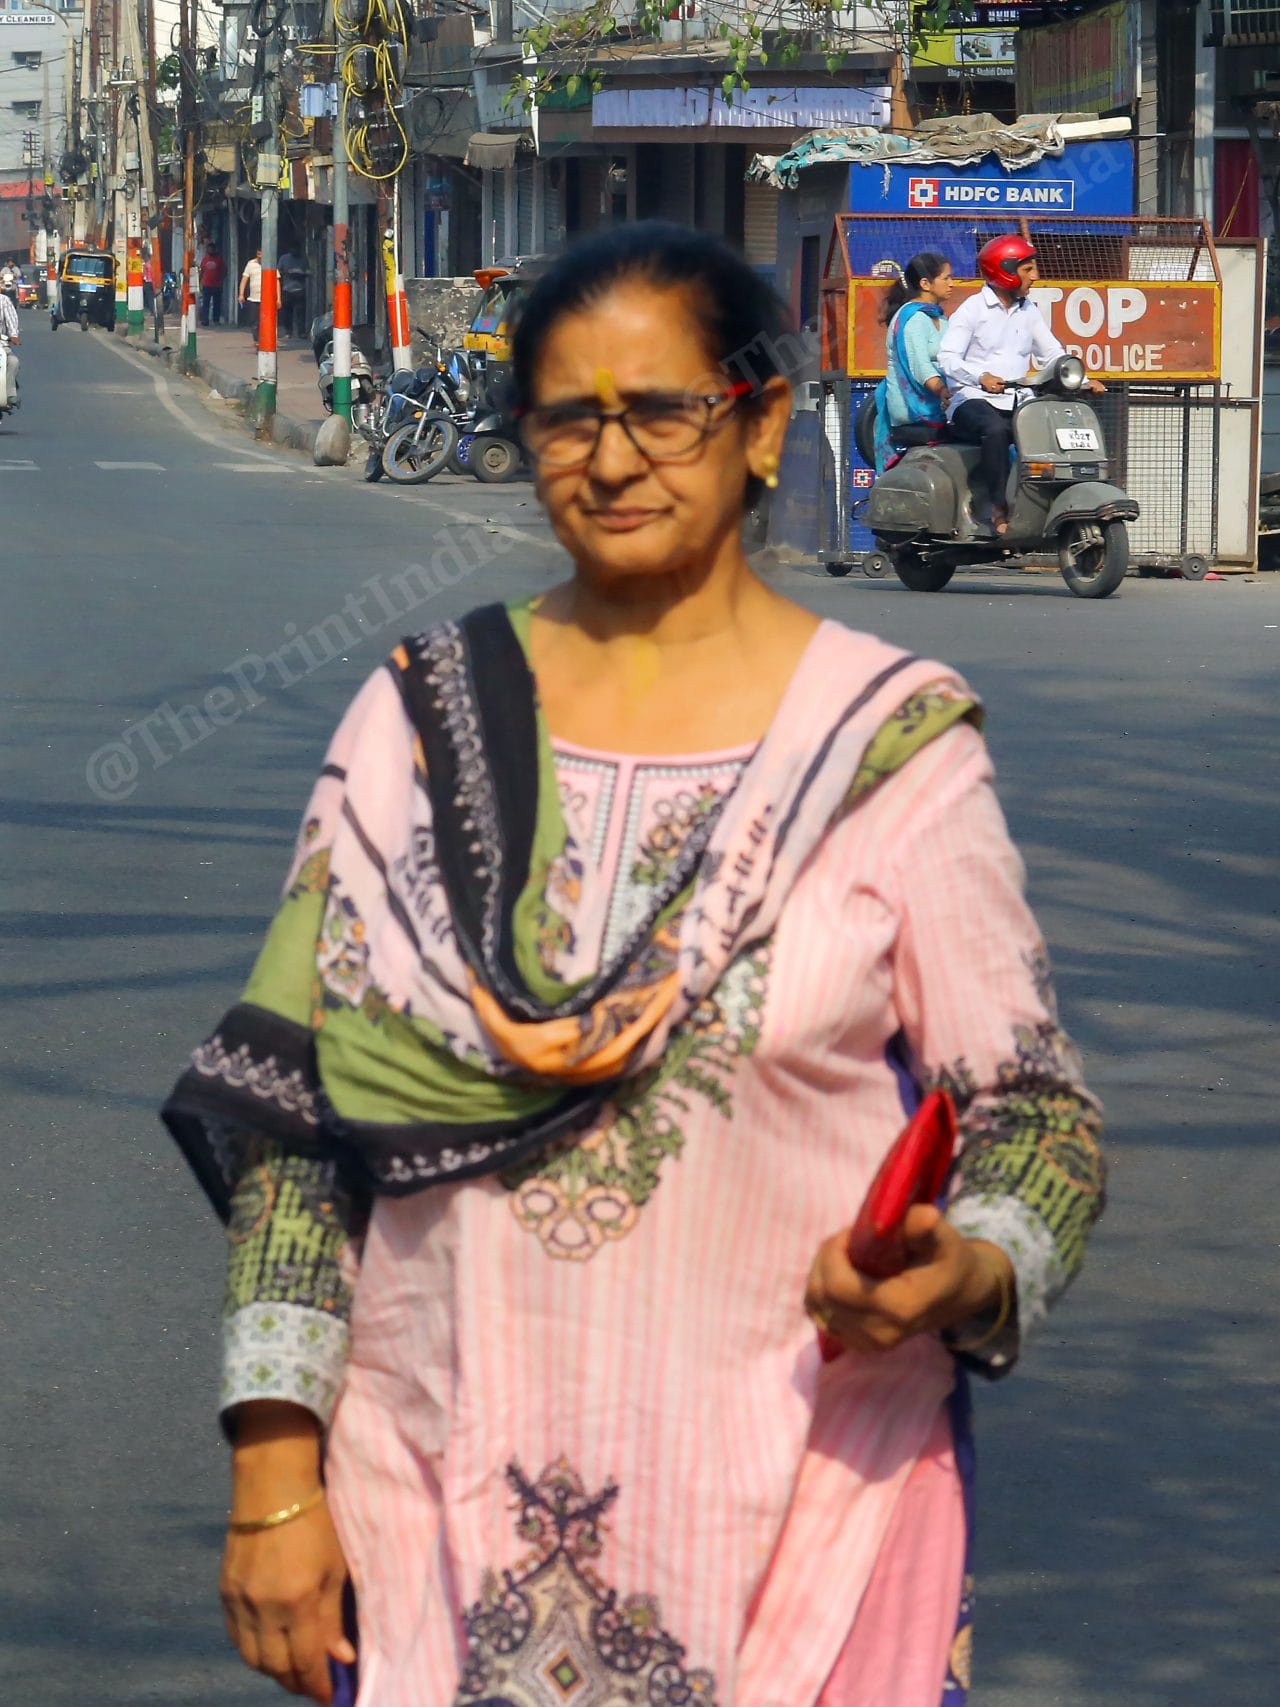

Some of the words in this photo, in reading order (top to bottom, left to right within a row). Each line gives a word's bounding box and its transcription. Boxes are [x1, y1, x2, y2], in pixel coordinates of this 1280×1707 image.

[945, 186, 1000, 202] HDFC
[1006, 187, 1065, 203] BANK
[1027, 287, 1147, 339] TOP
